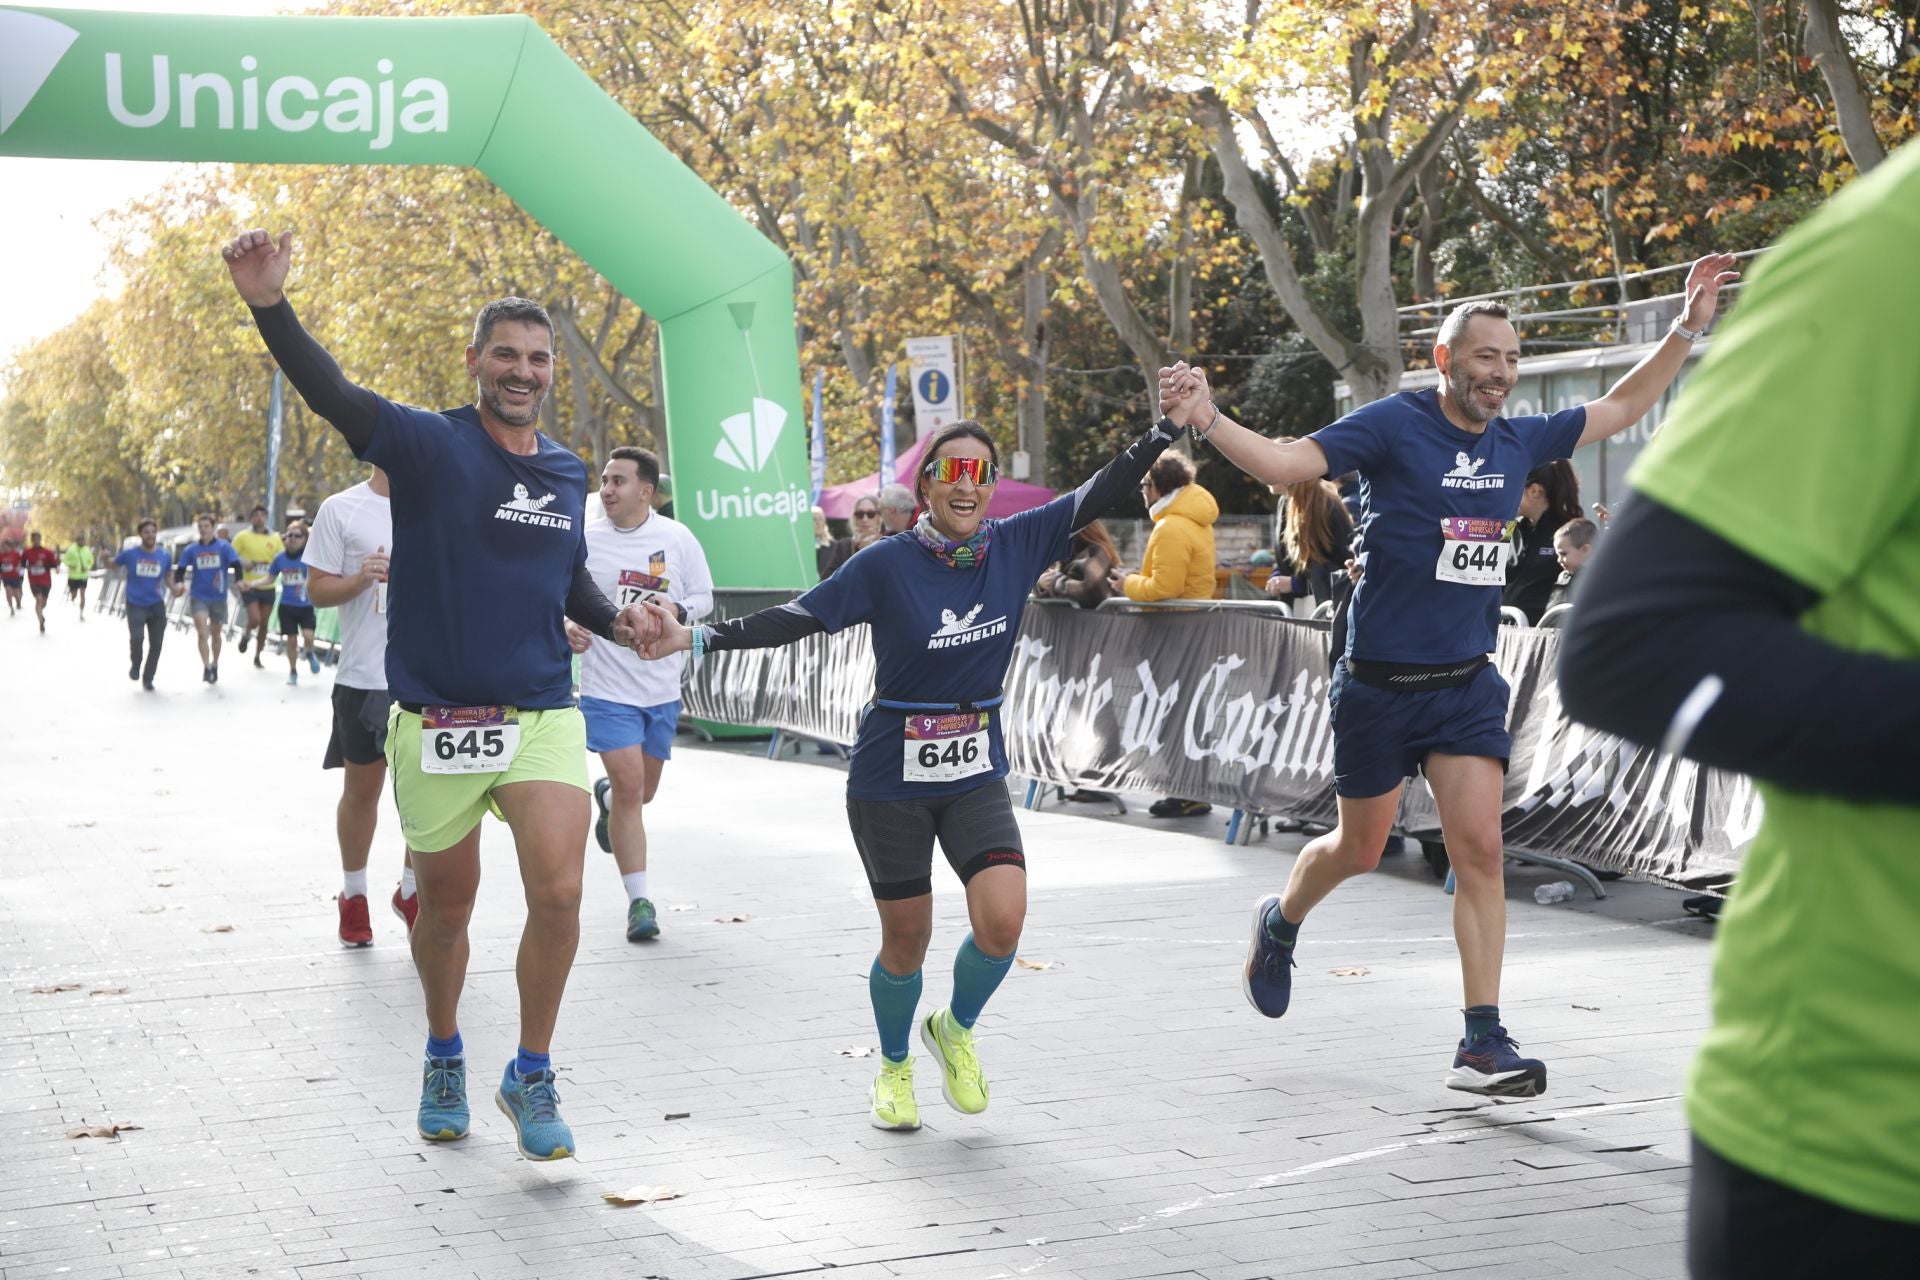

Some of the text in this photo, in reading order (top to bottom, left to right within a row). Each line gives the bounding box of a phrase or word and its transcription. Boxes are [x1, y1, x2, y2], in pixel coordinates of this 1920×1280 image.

[105, 52, 449, 150] Unicaja
[1441, 478, 1504, 490] MICHELIN
[696, 482, 808, 524] Unicaja
[494, 508, 572, 531] MICHELIN
[1468, 519, 1488, 527] CARRERA
[1468, 525, 1494, 534] EMPRESAS
[1452, 543, 1499, 572] 644
[927, 620, 1007, 649] MICHELIN
[936, 715, 960, 725] CARRERA
[1121, 658, 1180, 757] de
[936, 719, 968, 732] EMPRESAS
[434, 729, 504, 760] 645
[918, 736, 978, 768] 646
